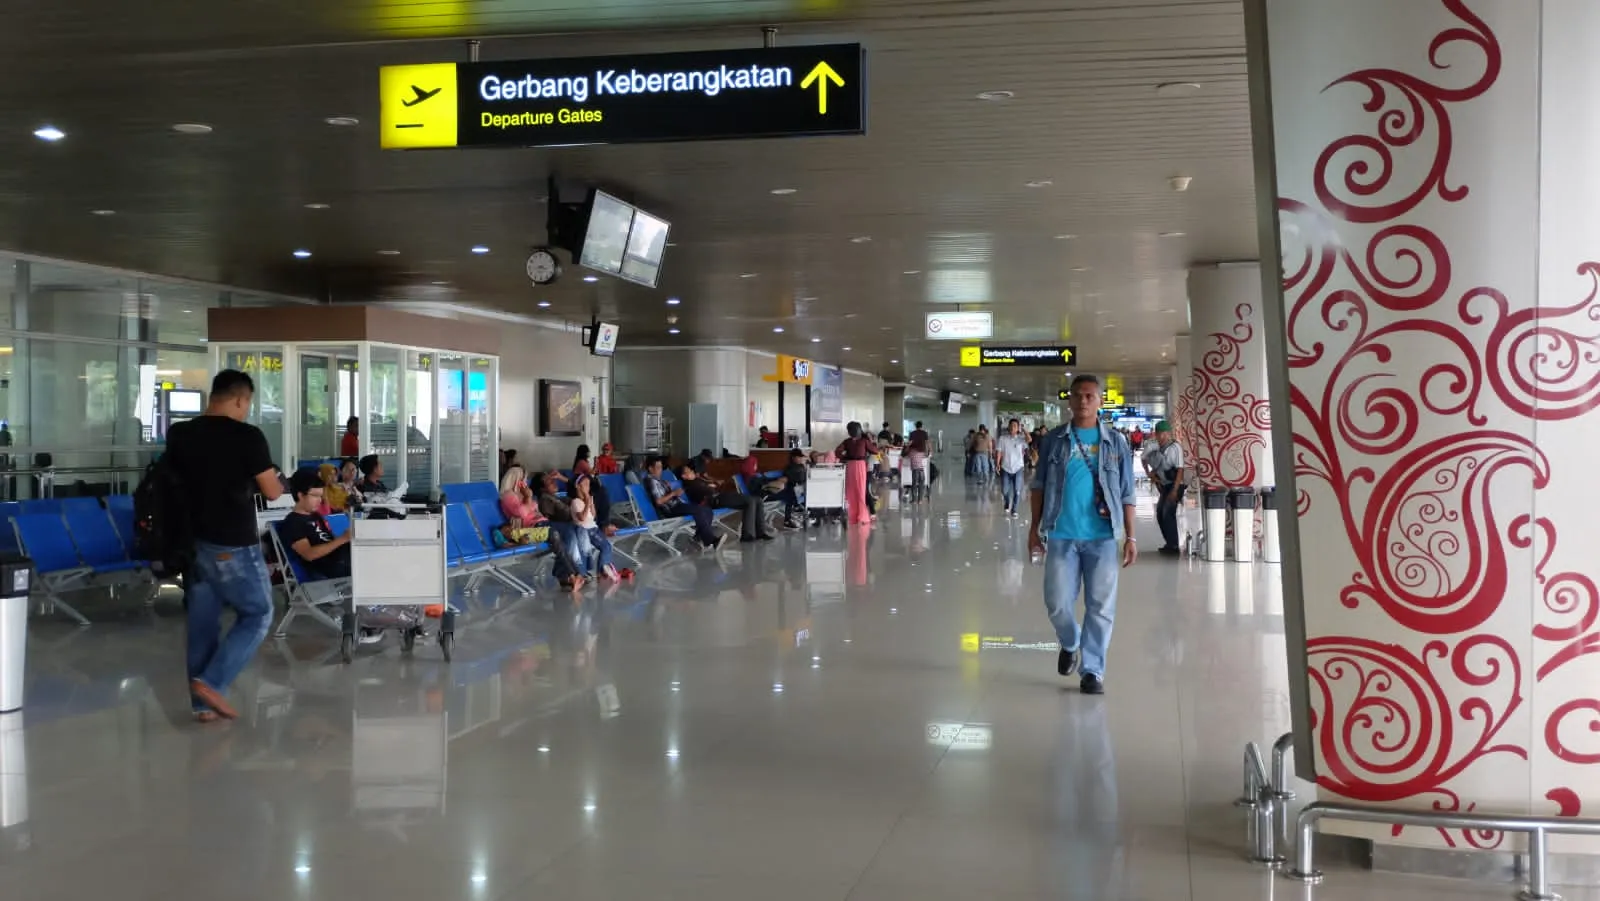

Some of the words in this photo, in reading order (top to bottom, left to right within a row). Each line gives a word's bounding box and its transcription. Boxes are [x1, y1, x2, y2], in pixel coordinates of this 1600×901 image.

[480, 74, 588, 102] Gerbang
[596, 64, 791, 96] Keberangkatan
[481, 111, 554, 129] Departure
[558, 108, 602, 124] Gates
